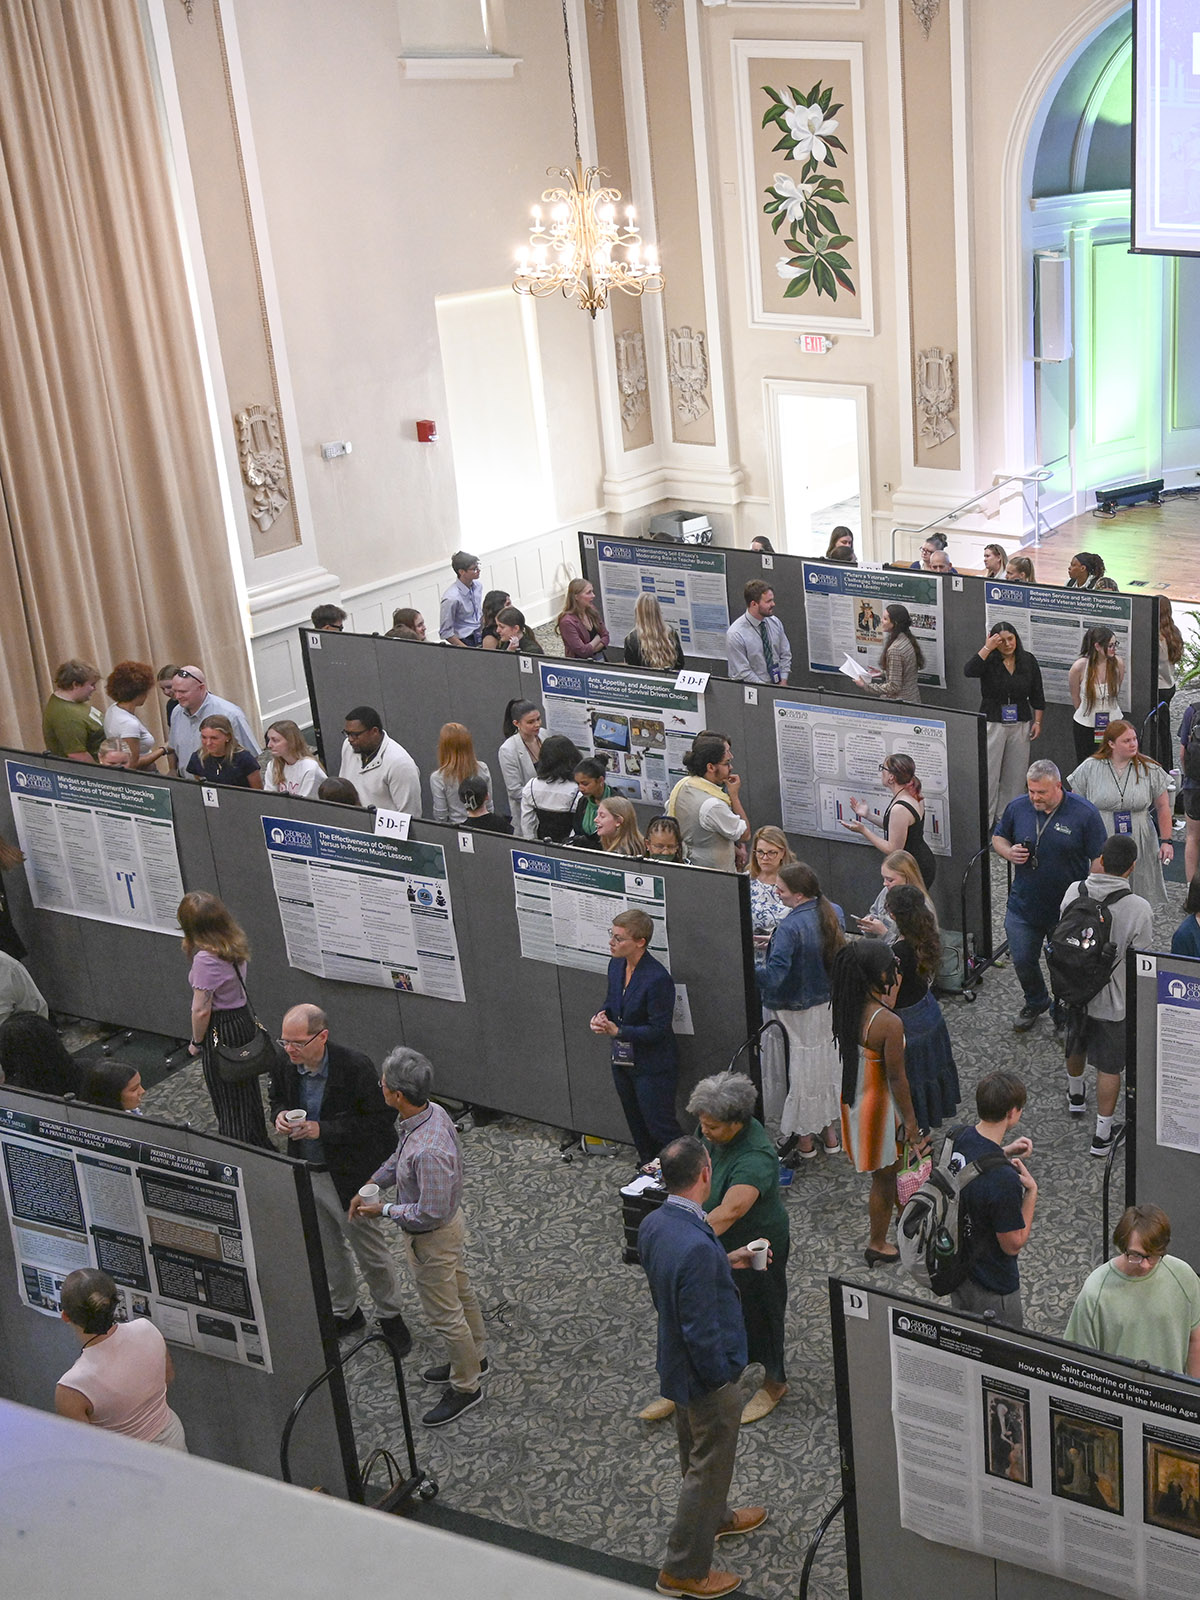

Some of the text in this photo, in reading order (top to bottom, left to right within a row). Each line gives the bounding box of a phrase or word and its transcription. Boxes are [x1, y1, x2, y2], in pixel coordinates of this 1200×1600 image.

[804, 336, 823, 352] EXIT
[586, 537, 593, 546] D
[765, 557, 771, 566] E
[954, 580, 960, 588] F
[1096, 603, 1121, 611] Formation
[311, 636, 319, 645] D
[523, 660, 530, 669] E
[602, 679, 627, 689] Appetite,
[639, 683, 670, 693] Adaptation:
[680, 675, 705, 687] 3 D-F
[588, 682, 599, 690] The
[600, 684, 621, 693] Science
[628, 687, 649, 696] Survival
[650, 690, 668, 699] Driven
[669, 692, 689, 701] Choice
[748, 691, 754, 701] F
[57, 775, 80, 786] Mindset
[87, 780, 124, 793] Environment?
[125, 786, 155, 800] Unpacking
[58, 782, 69, 790] the
[69, 784, 92, 794] Sources
[99, 789, 121, 799] Teacher
[121, 793, 144, 803] Burnout
[206, 792, 214, 802] E
[378, 817, 407, 833] 5 D-F
[319, 831, 398, 852] The Effectiveness of Online
[462, 838, 468, 847] F
[320, 838, 340, 849] Versus
[340, 842, 368, 855] In-Person
[369, 846, 388, 857] Music
[388, 849, 413, 862] Lessons
[1142, 959, 1152, 971] D
[849, 1294, 863, 1309] D
[1061, 1363, 1152, 1397] Saint Catherine of Siena:
[1018, 1361, 1198, 1419] How She Was Depicted in Art in the Middle Ages
